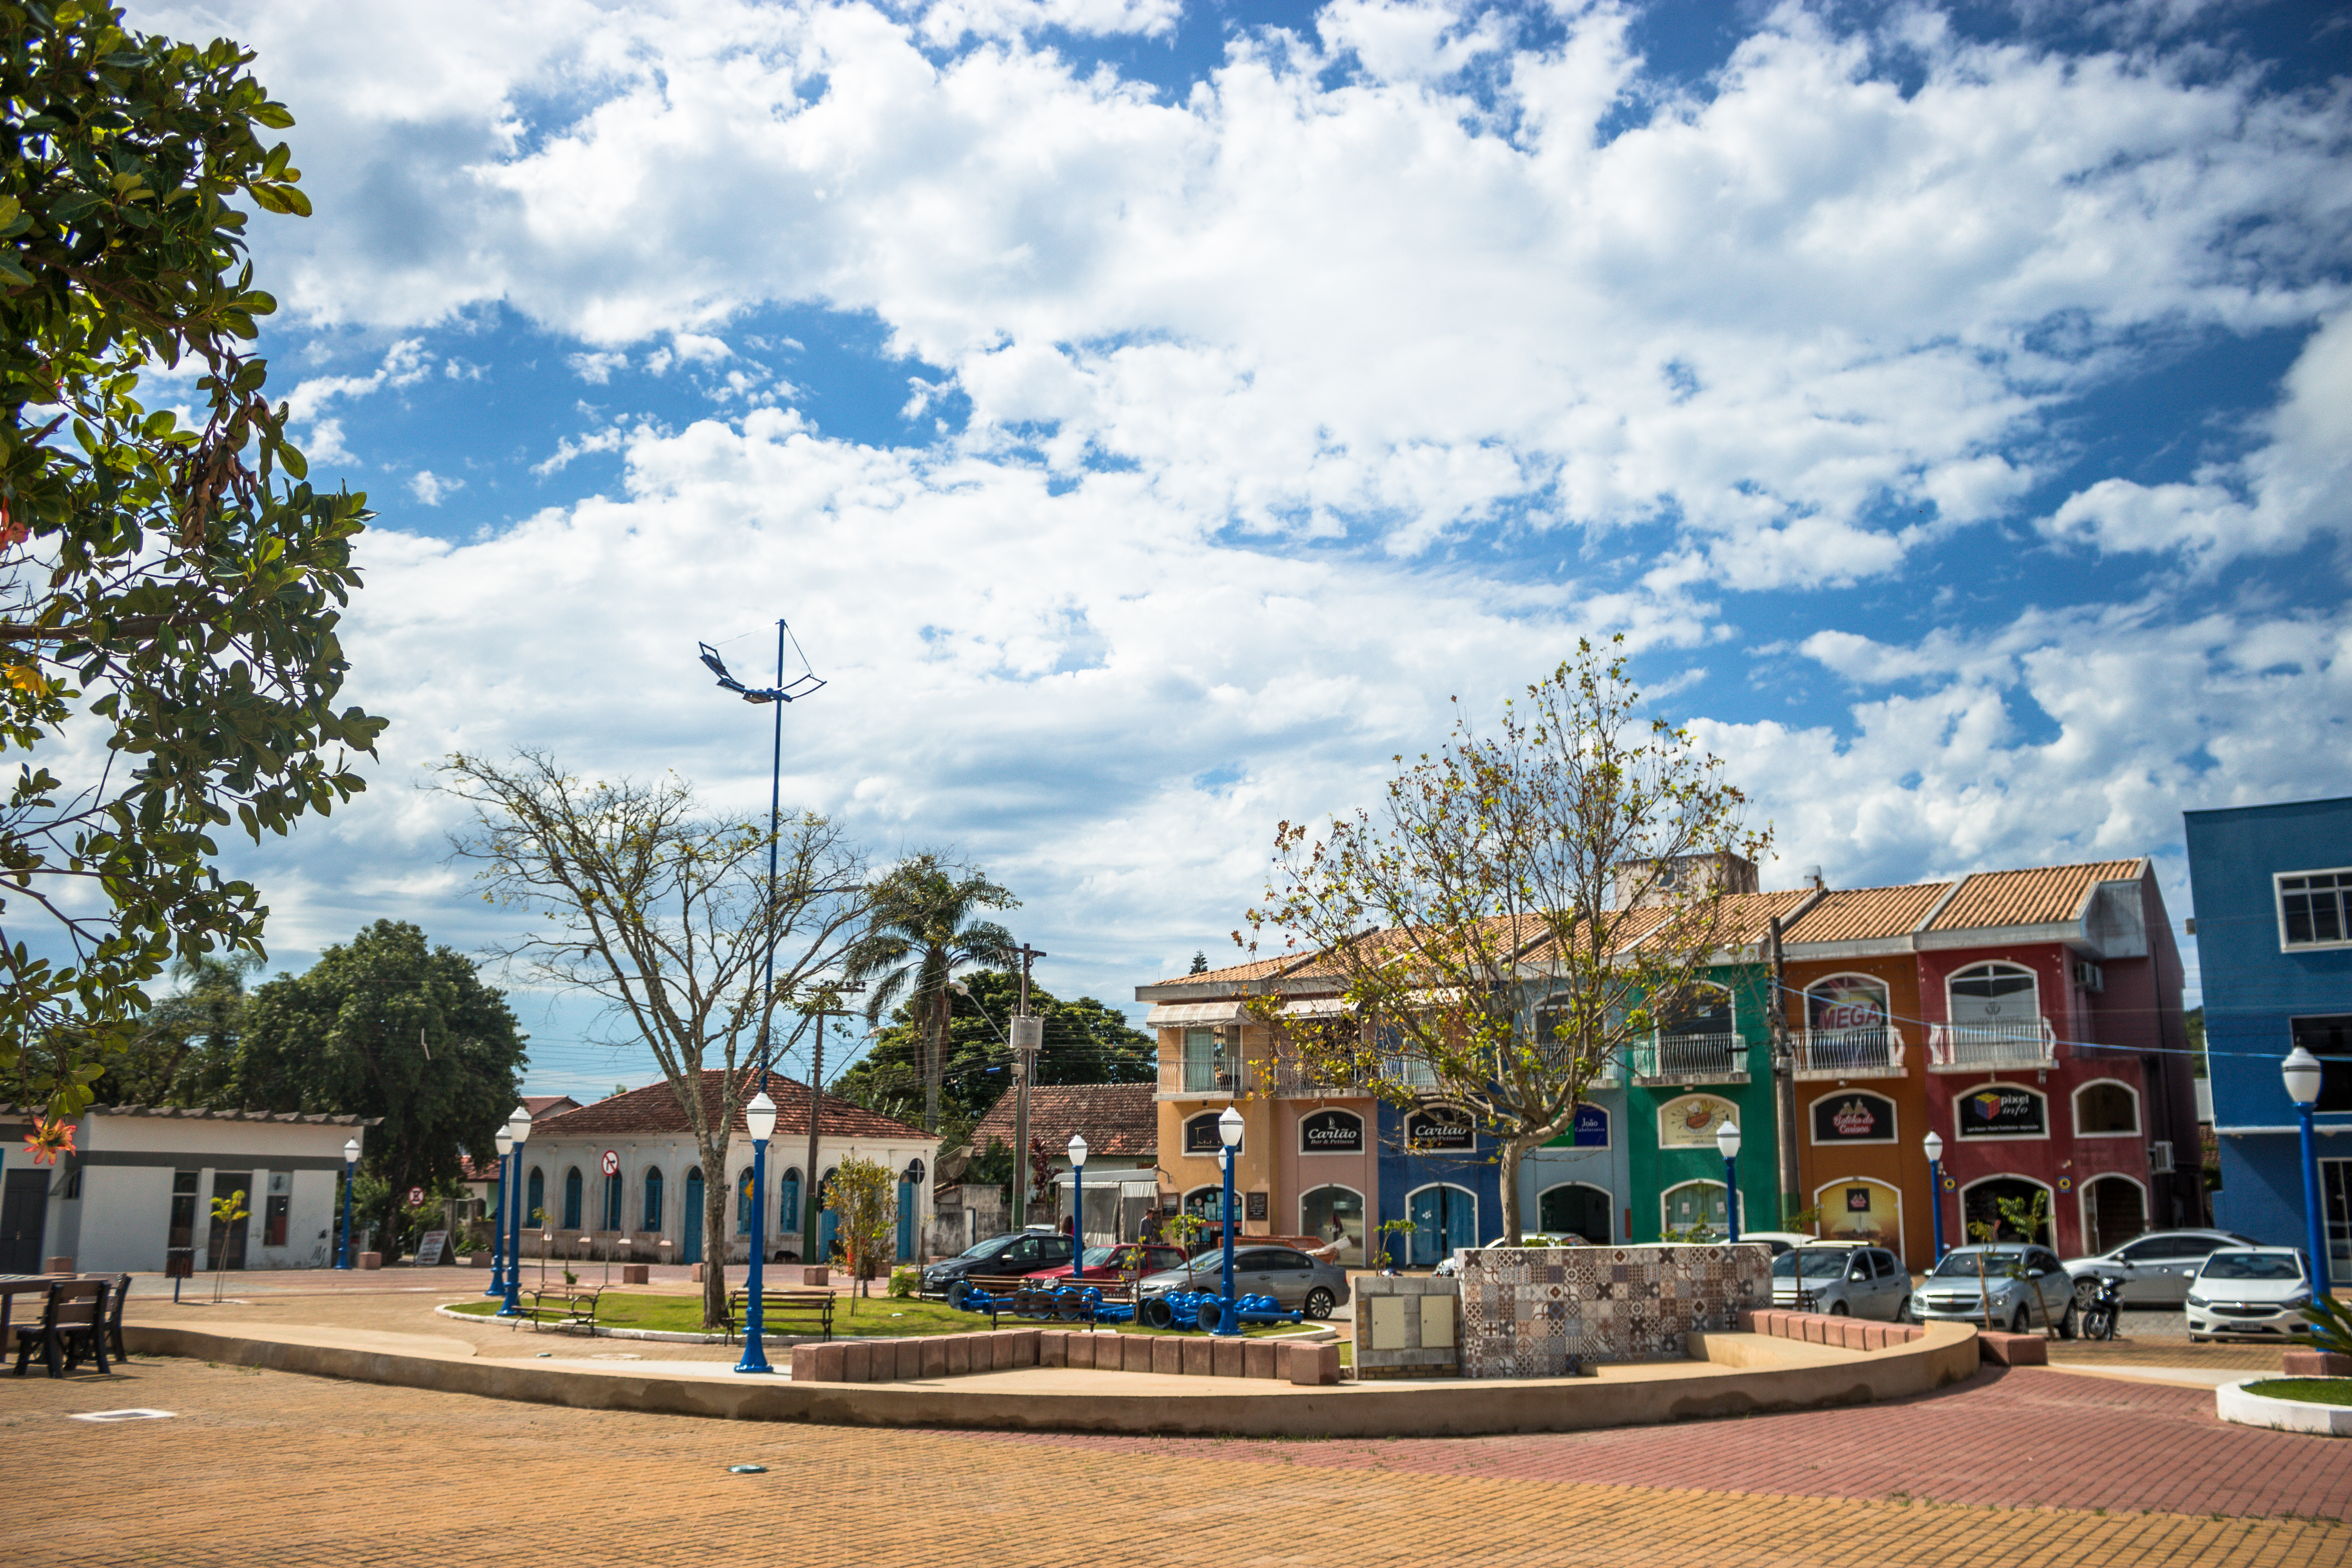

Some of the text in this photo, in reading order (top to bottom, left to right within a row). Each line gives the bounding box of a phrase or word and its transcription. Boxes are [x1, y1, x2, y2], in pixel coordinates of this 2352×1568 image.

[1818, 1003, 1880, 1030] MEGA
[2001, 1094, 2029, 1106] pixel
[2002, 1104, 2028, 1117] info
[1582, 1117, 1598, 1127] João
[1308, 1128, 1357, 1139] Carlão
